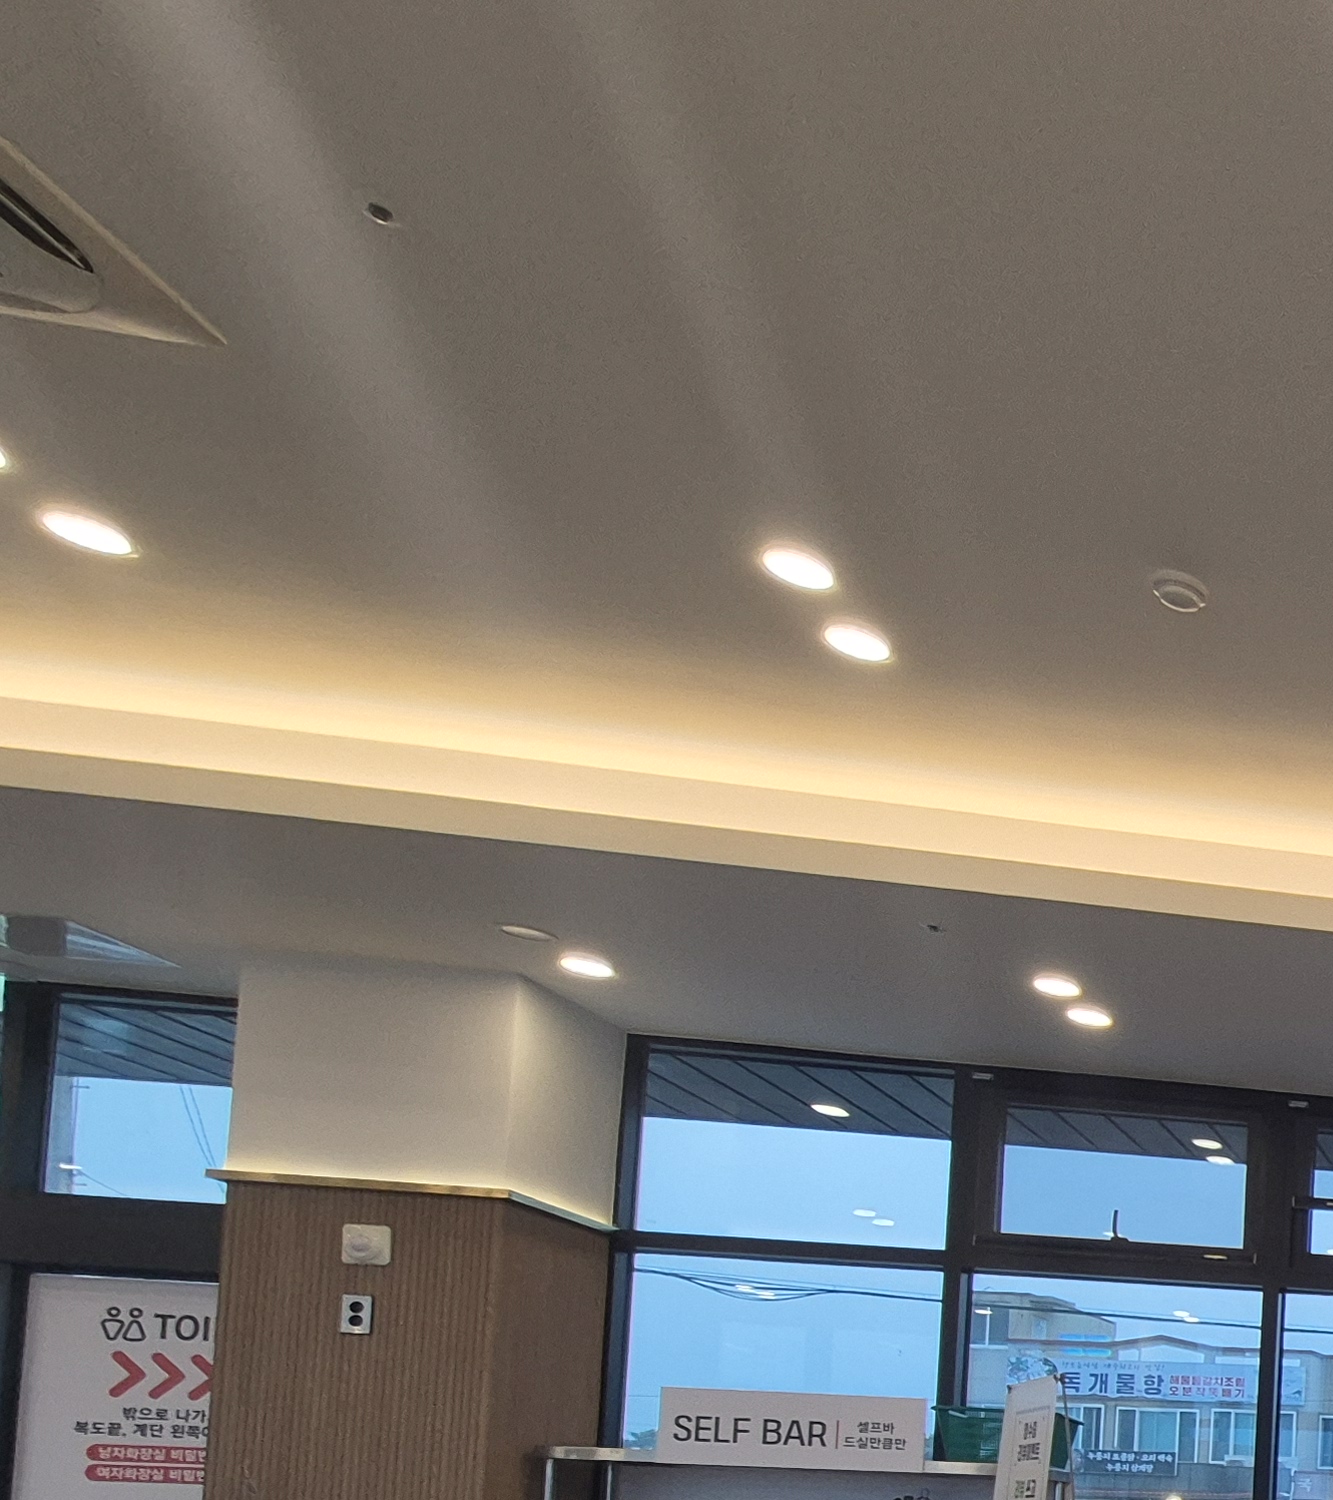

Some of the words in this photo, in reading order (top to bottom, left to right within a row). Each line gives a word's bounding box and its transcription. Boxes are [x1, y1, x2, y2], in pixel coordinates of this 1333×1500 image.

[123, 1407, 168, 1422] 밖으로
[175, 1409, 209, 1423] 나가
[133, 1423, 164, 1438] 계단
[672, 1414, 752, 1445] SELF
[761, 1418, 827, 1448] BAR
[856, 1421, 895, 1436] 셀프바
[842, 1436, 907, 1451] 드실만큼만
[98, 1446, 166, 1461] 남자화장실
[96, 1467, 164, 1481] 여자화장실
